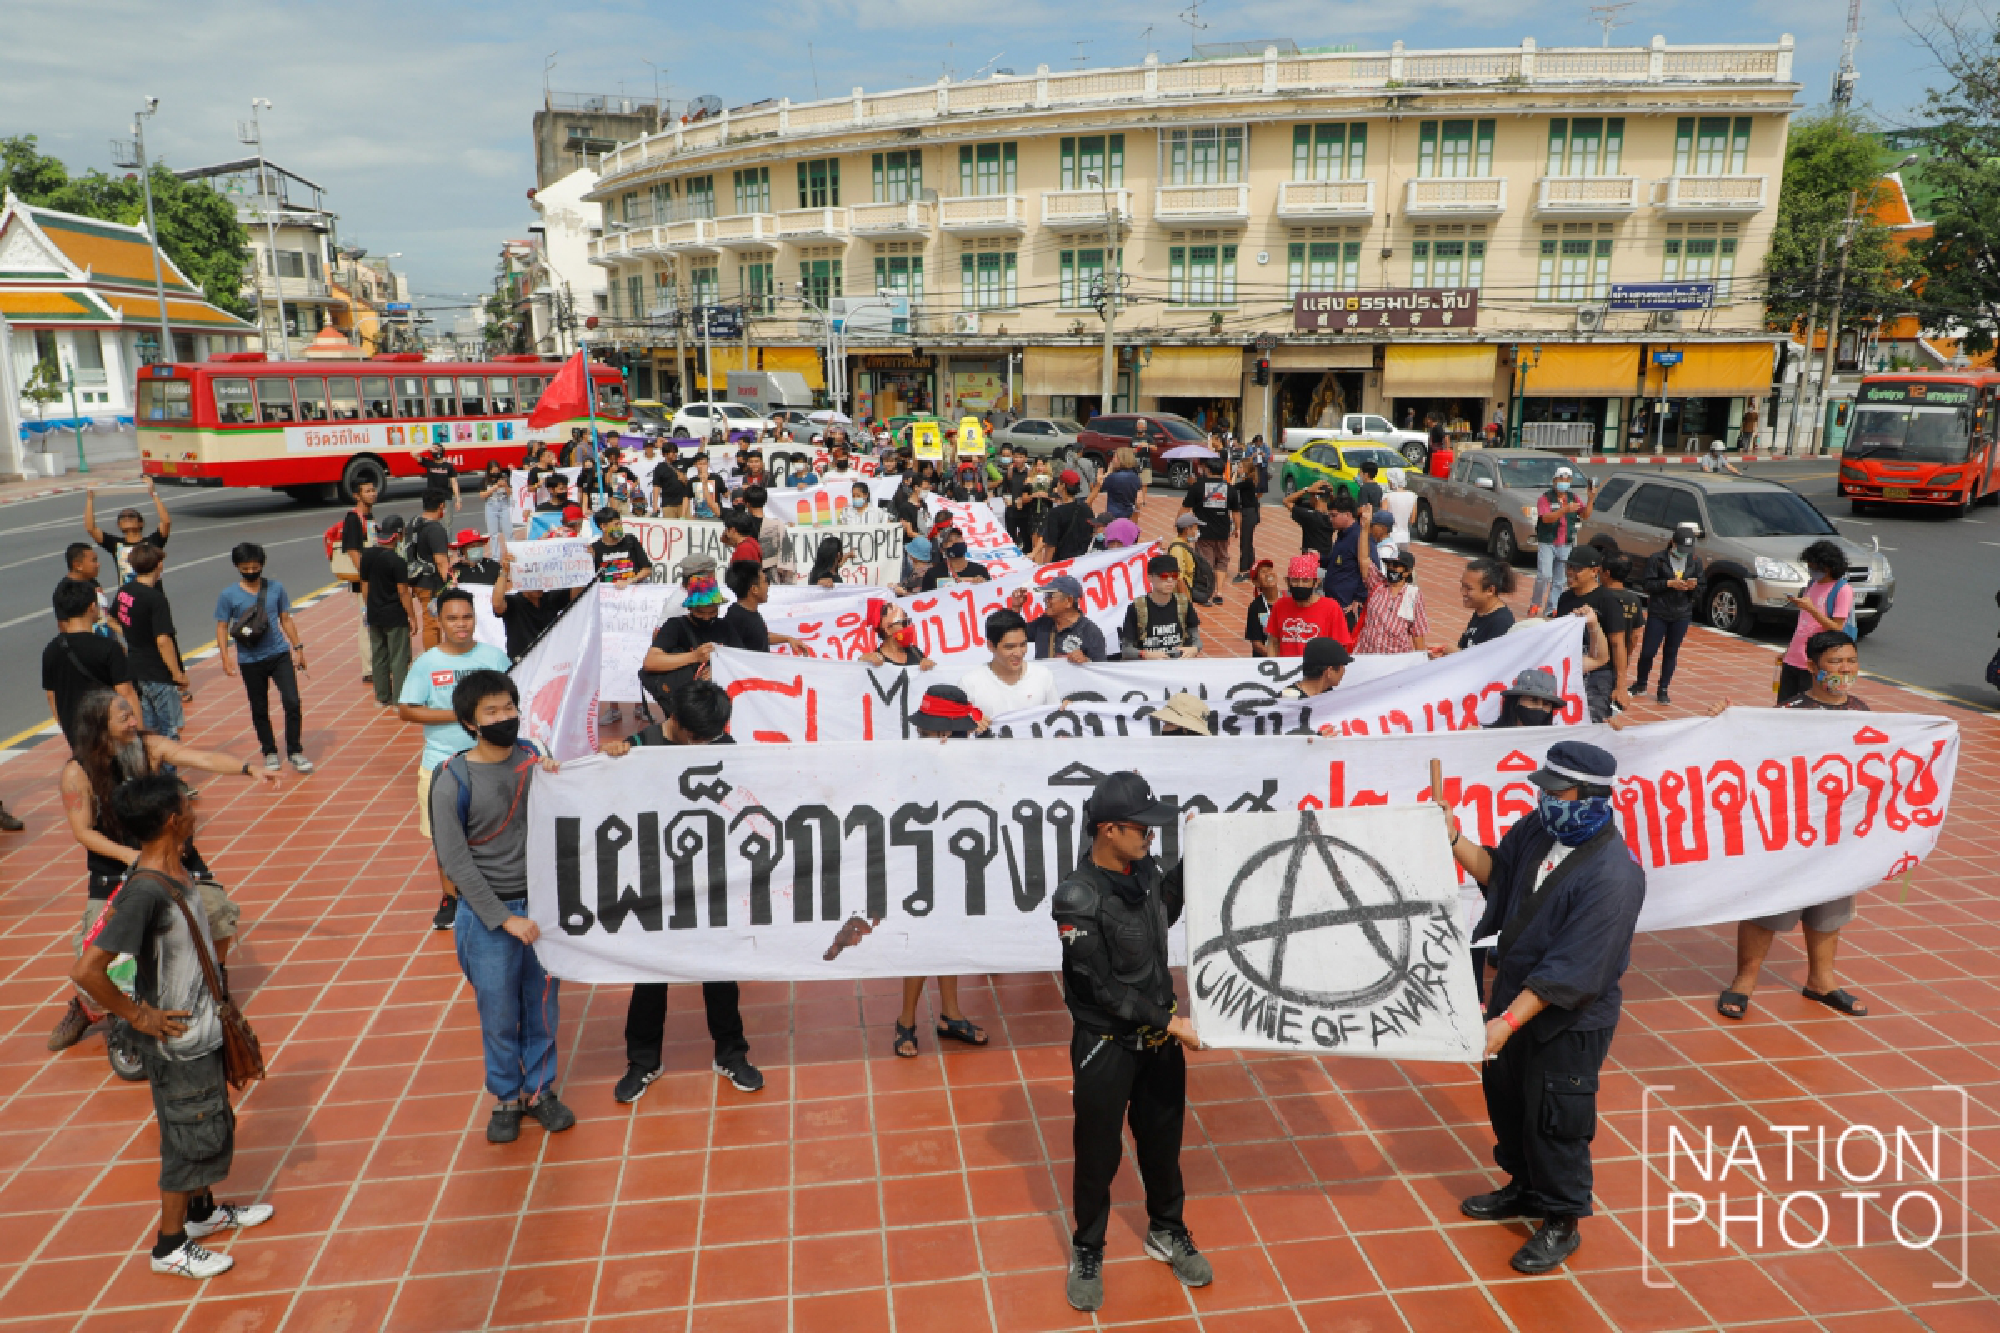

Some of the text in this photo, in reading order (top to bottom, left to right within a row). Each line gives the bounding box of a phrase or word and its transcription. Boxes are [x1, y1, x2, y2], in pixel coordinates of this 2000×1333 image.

[1908, 384, 1927, 397] 12
[304, 427, 371, 449] ชีวิตวิถีใหม่
[622, 521, 684, 562] TOP
[554, 760, 1279, 936] เผด็จการจงพิ
